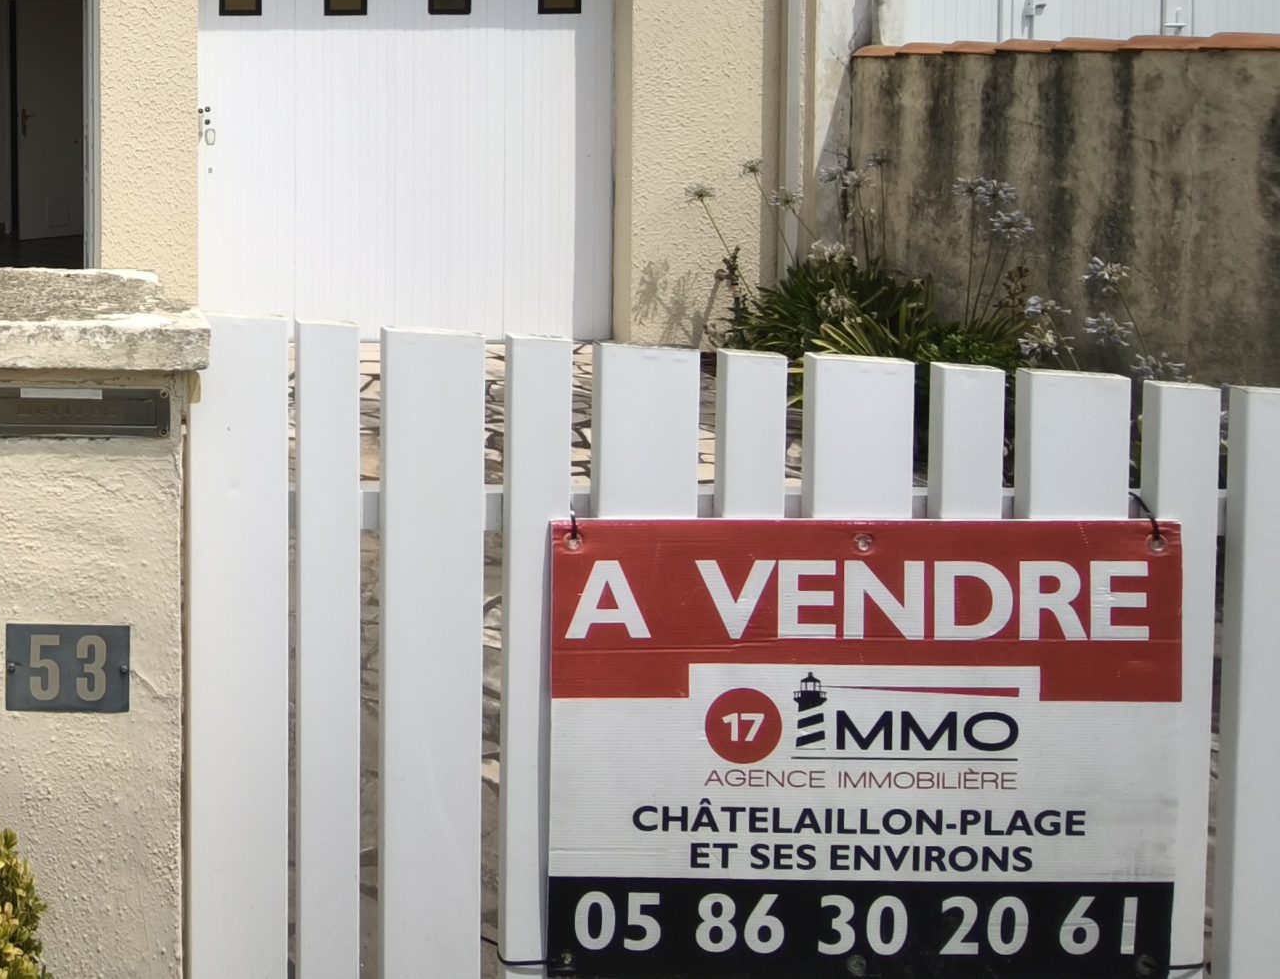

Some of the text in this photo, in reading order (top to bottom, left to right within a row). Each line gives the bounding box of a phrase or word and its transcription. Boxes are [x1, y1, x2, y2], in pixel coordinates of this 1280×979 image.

[565, 559, 1149, 641] A VENDRE
[28, 634, 108, 702] 53
[721, 712, 765, 742] 17
[704, 768, 1018, 790] AGENCE IMMOBILIÈRE
[632, 797, 1086, 837] CHÂTELAILLON-PLAGE
[690, 843, 1033, 872] ET SES ENVIRONS
[574, 891, 1139, 957] 05 86 30 20 61
